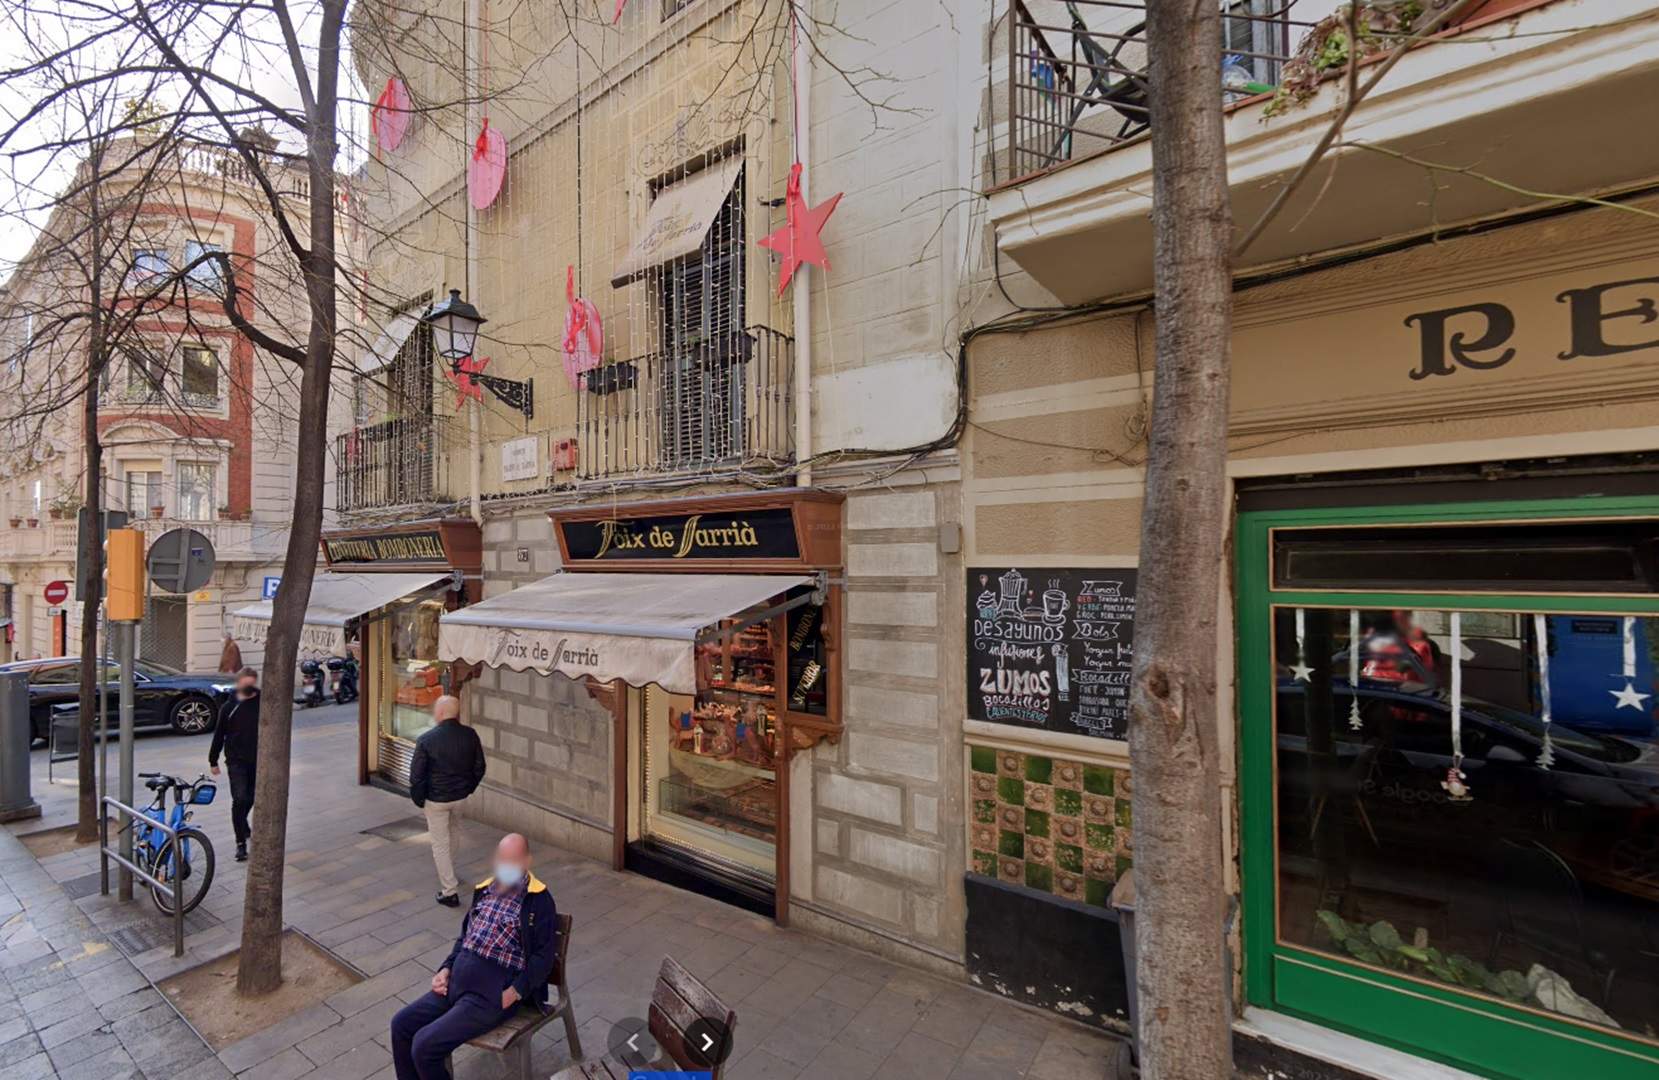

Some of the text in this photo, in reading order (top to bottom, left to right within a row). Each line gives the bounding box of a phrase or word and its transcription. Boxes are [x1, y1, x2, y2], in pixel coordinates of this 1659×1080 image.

[377, 536, 445, 559] BOMBONERIA
[594, 515, 758, 559] Foix de Sarrià
[267, 578, 281, 597] P
[491, 629, 599, 672] Foix de Sarrià
[980, 667, 1051, 696] ZUMOS
